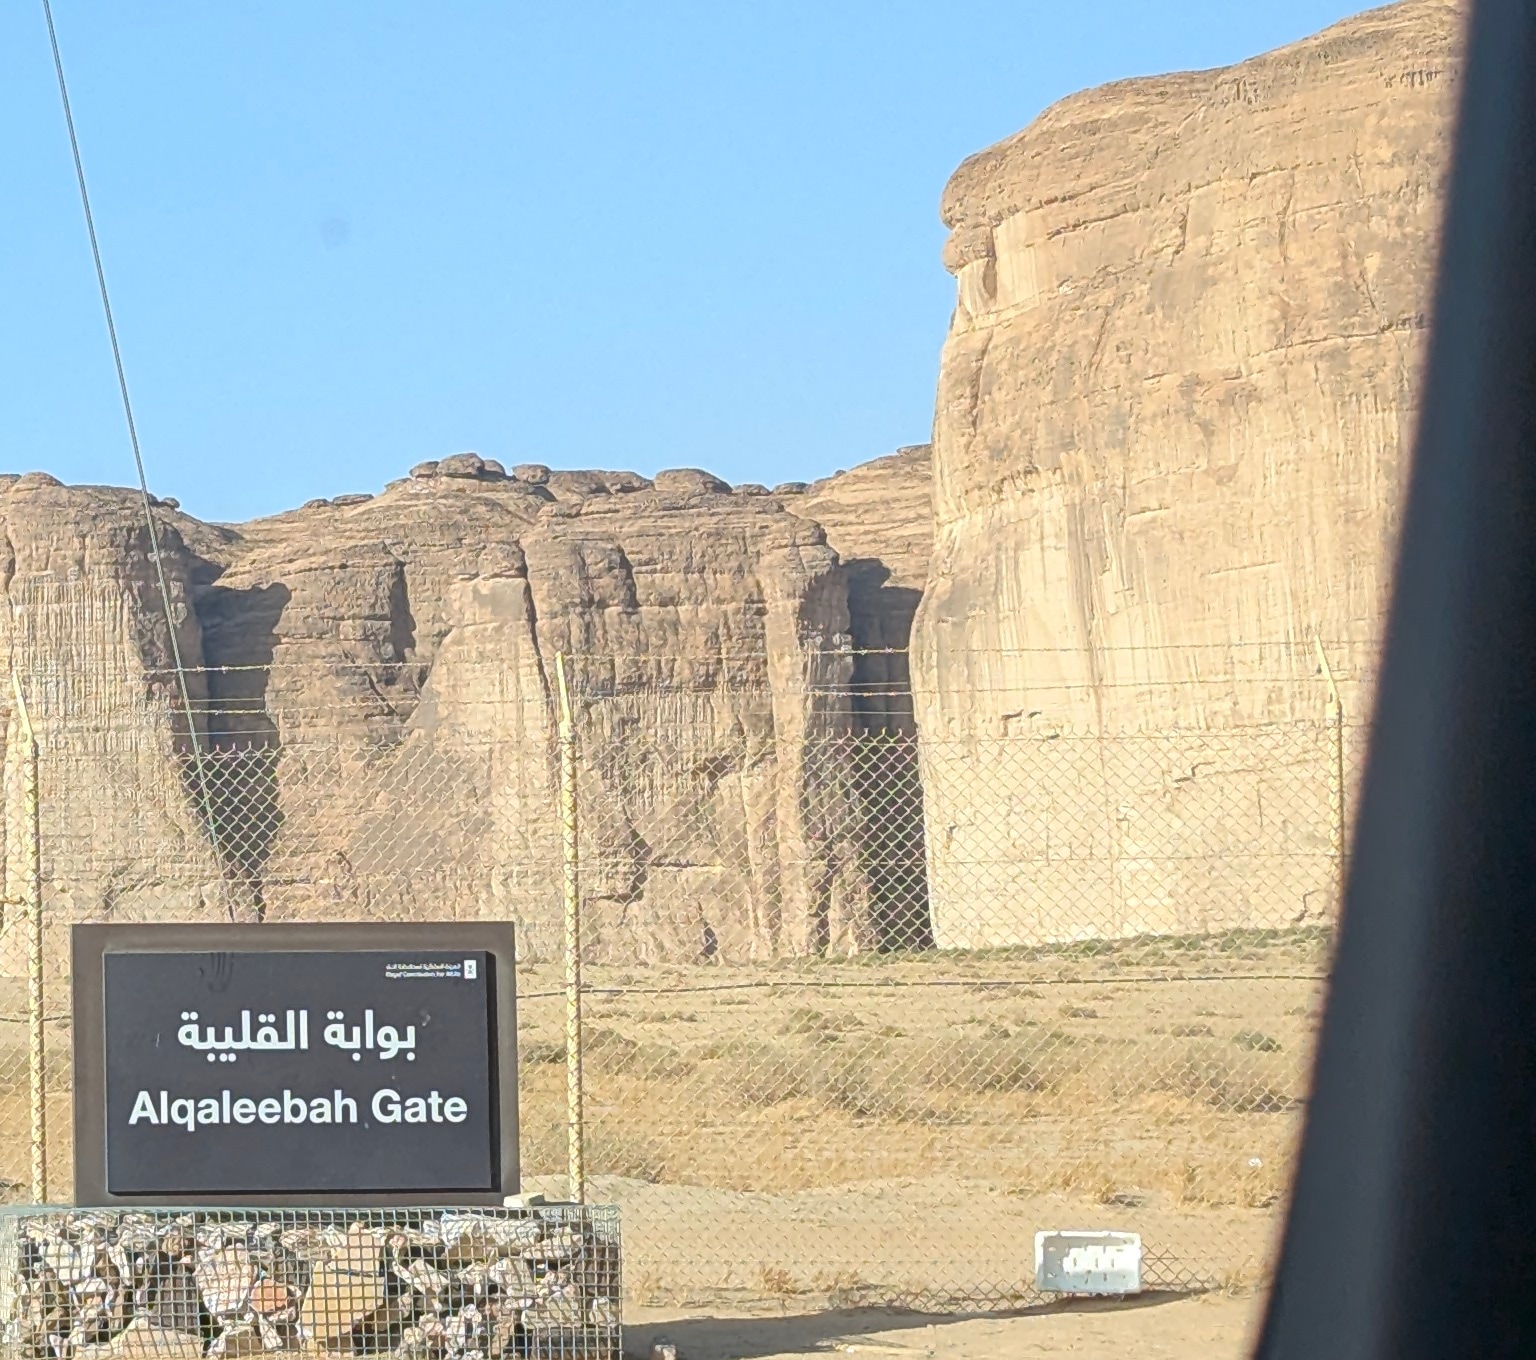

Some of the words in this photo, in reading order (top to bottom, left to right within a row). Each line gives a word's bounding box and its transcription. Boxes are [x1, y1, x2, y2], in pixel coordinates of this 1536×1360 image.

[177, 1009, 309, 1063] القليبة
[323, 1008, 416, 1062] بوابة
[128, 1089, 358, 1132] Alqaleebah
[371, 1088, 468, 1124] Gate
